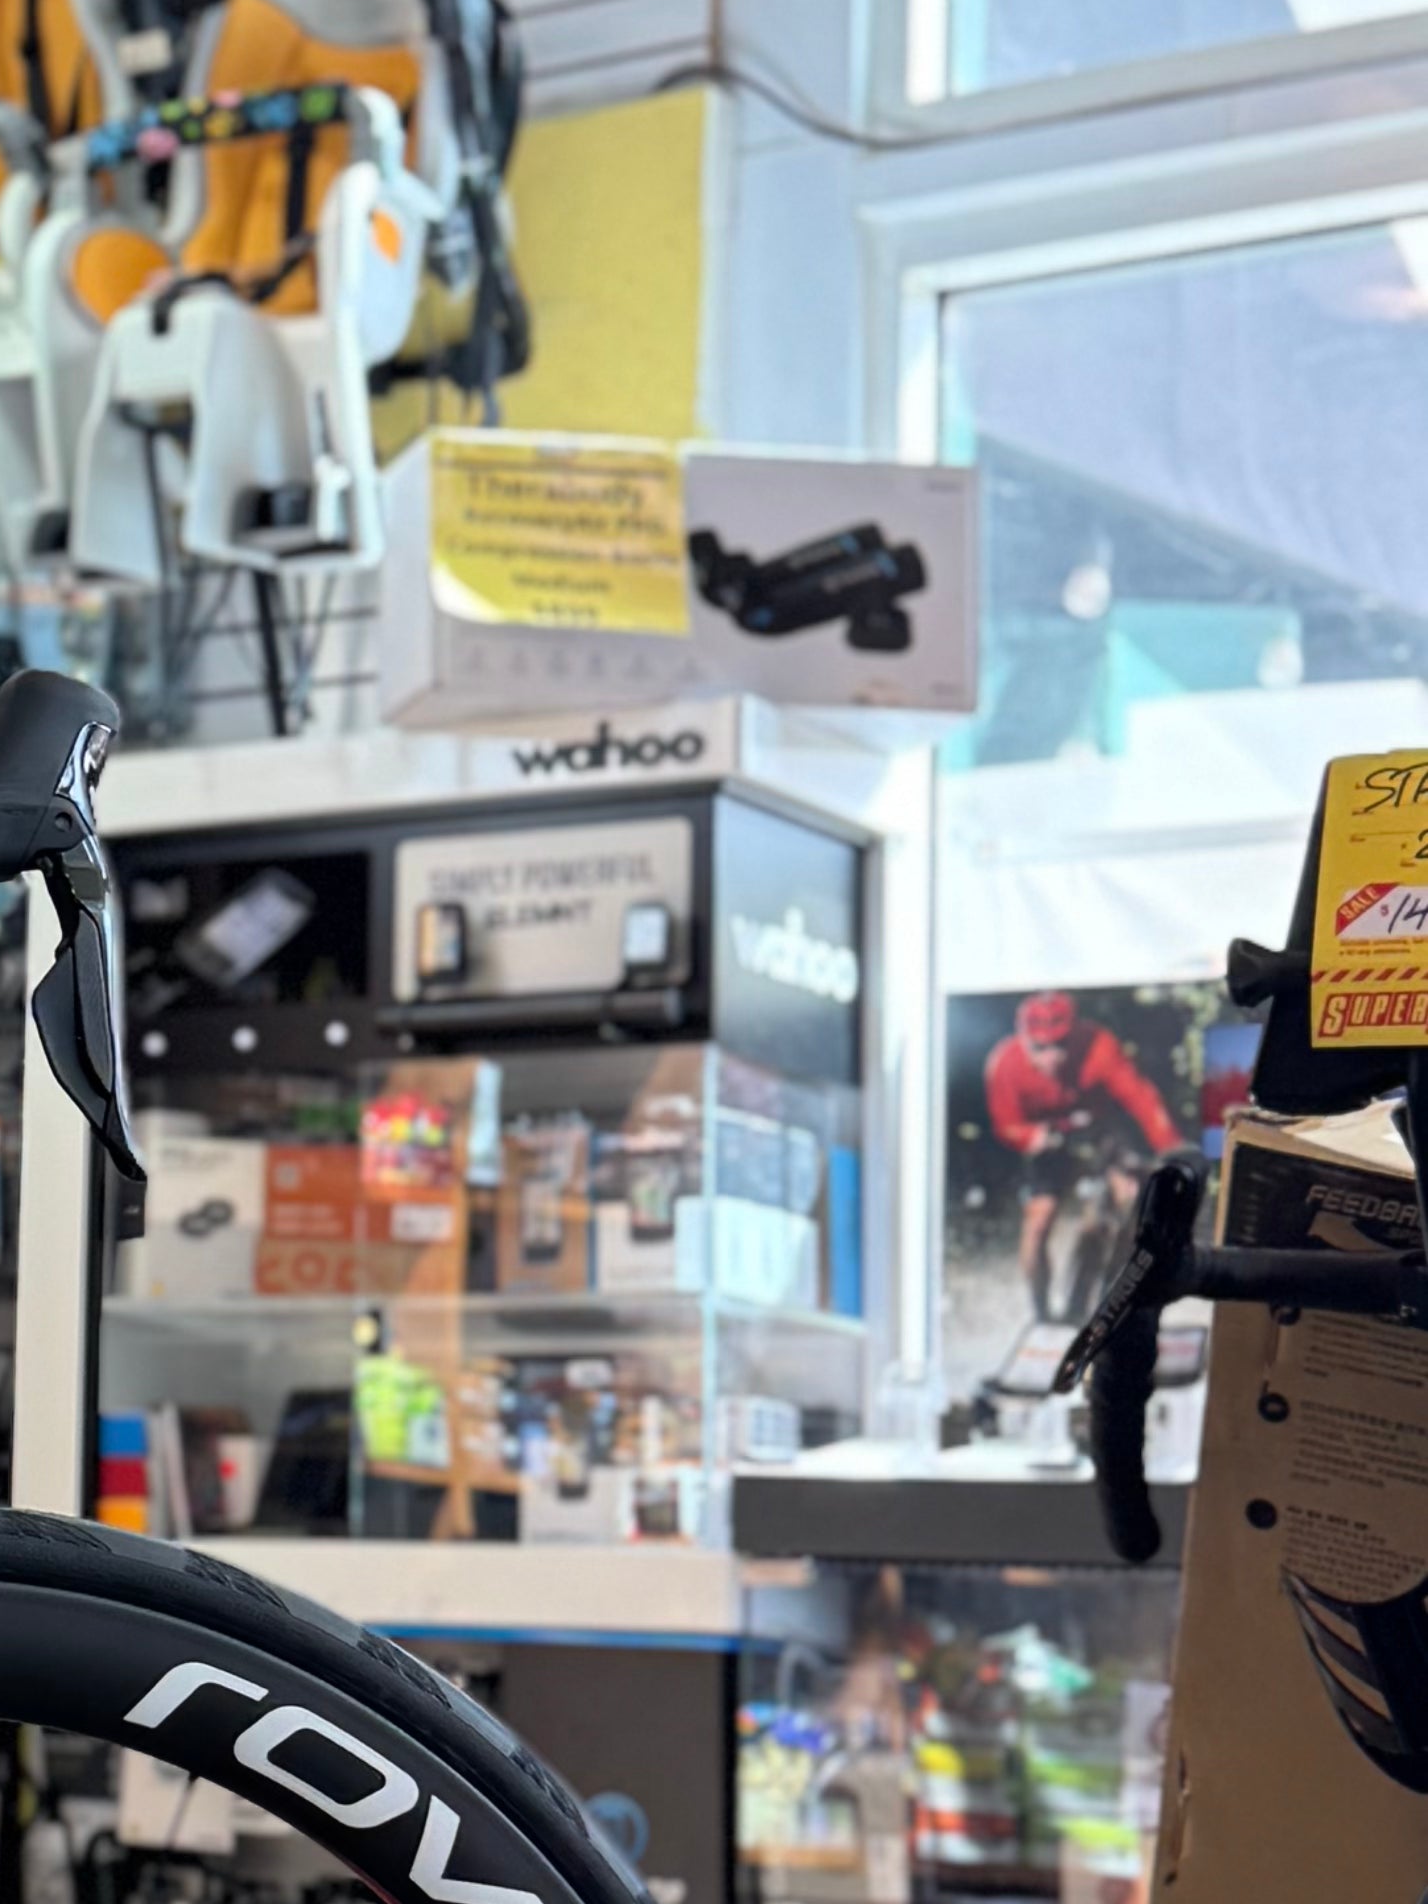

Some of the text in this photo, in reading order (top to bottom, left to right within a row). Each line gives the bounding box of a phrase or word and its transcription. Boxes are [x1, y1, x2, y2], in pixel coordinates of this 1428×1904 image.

[512, 718, 707, 780] wahoo
[1339, 885, 1380, 922] SALE
[730, 905, 860, 1005] wahoo
